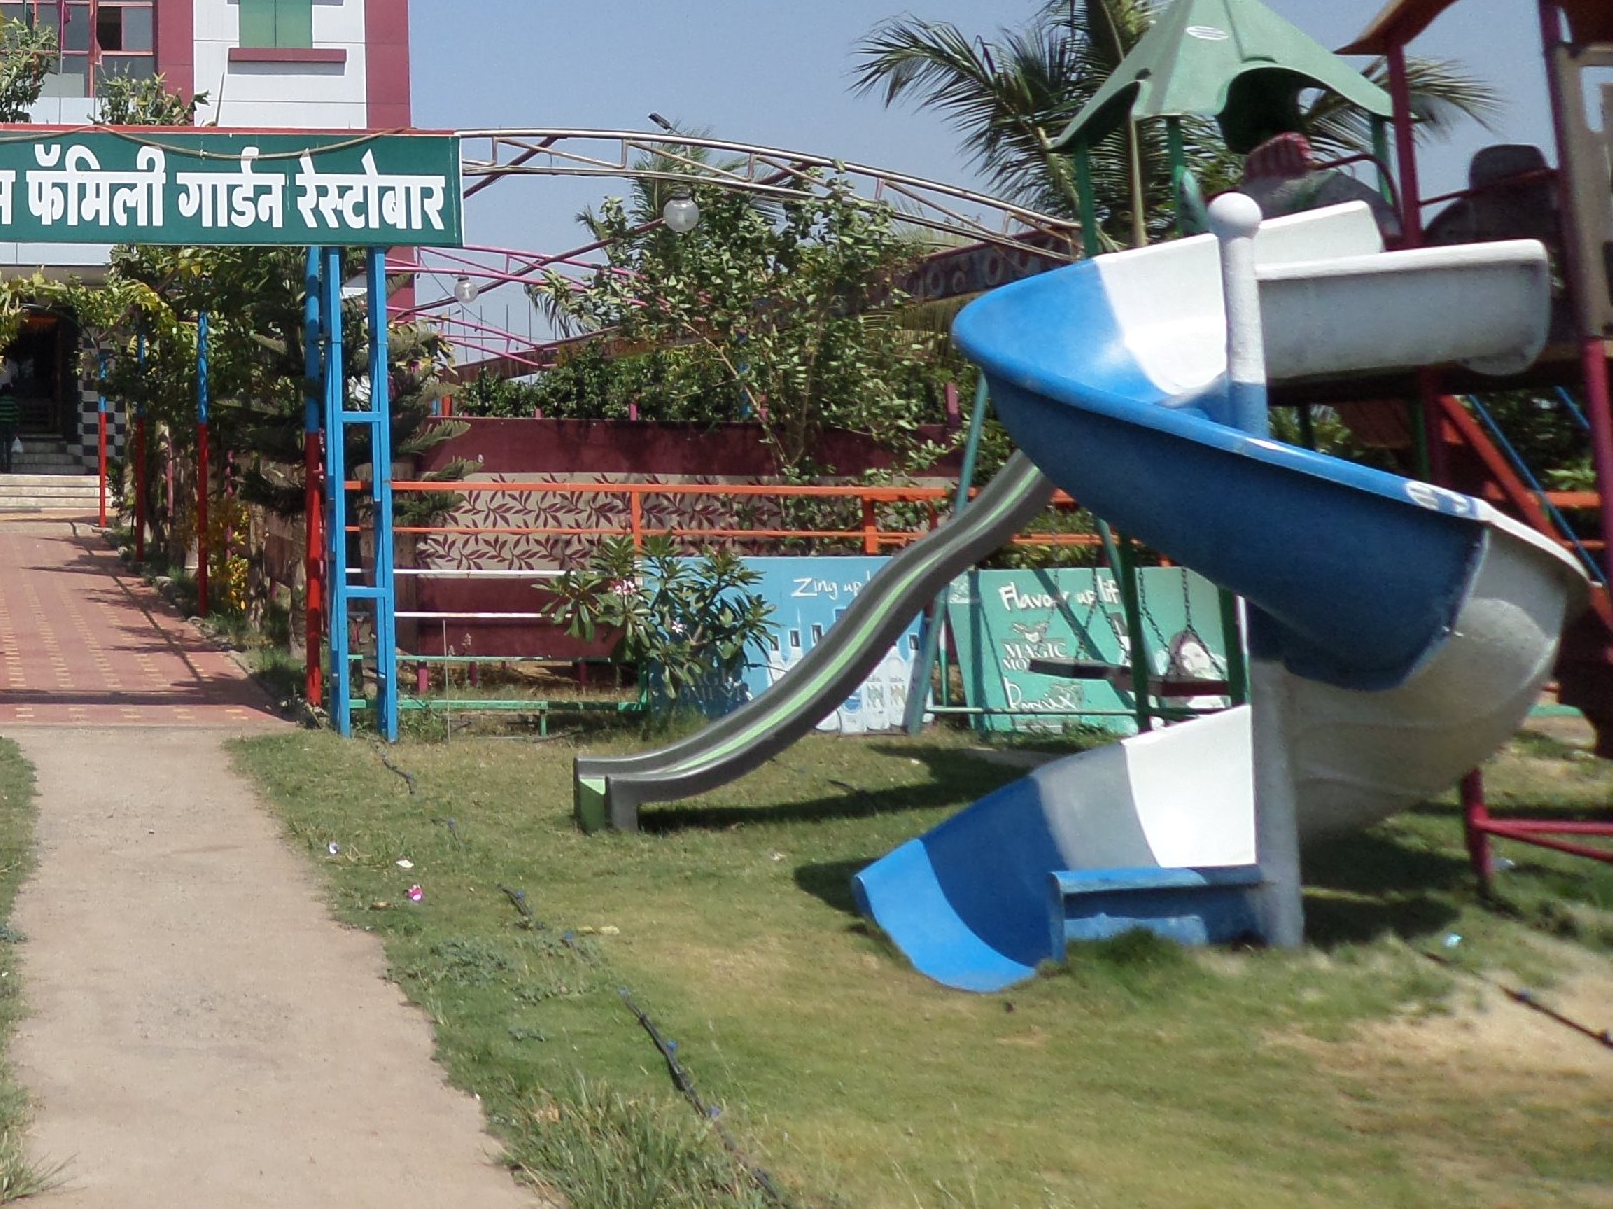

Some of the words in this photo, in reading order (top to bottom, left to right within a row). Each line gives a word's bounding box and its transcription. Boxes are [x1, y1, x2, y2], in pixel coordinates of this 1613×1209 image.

[26, 143, 166, 226] फॅमिली
[176, 146, 286, 227] गार्डन
[295, 147, 446, 230] रेस्टोबार
[791, 577, 838, 600] Zing
[1003, 642, 1067, 659] MAGIC
